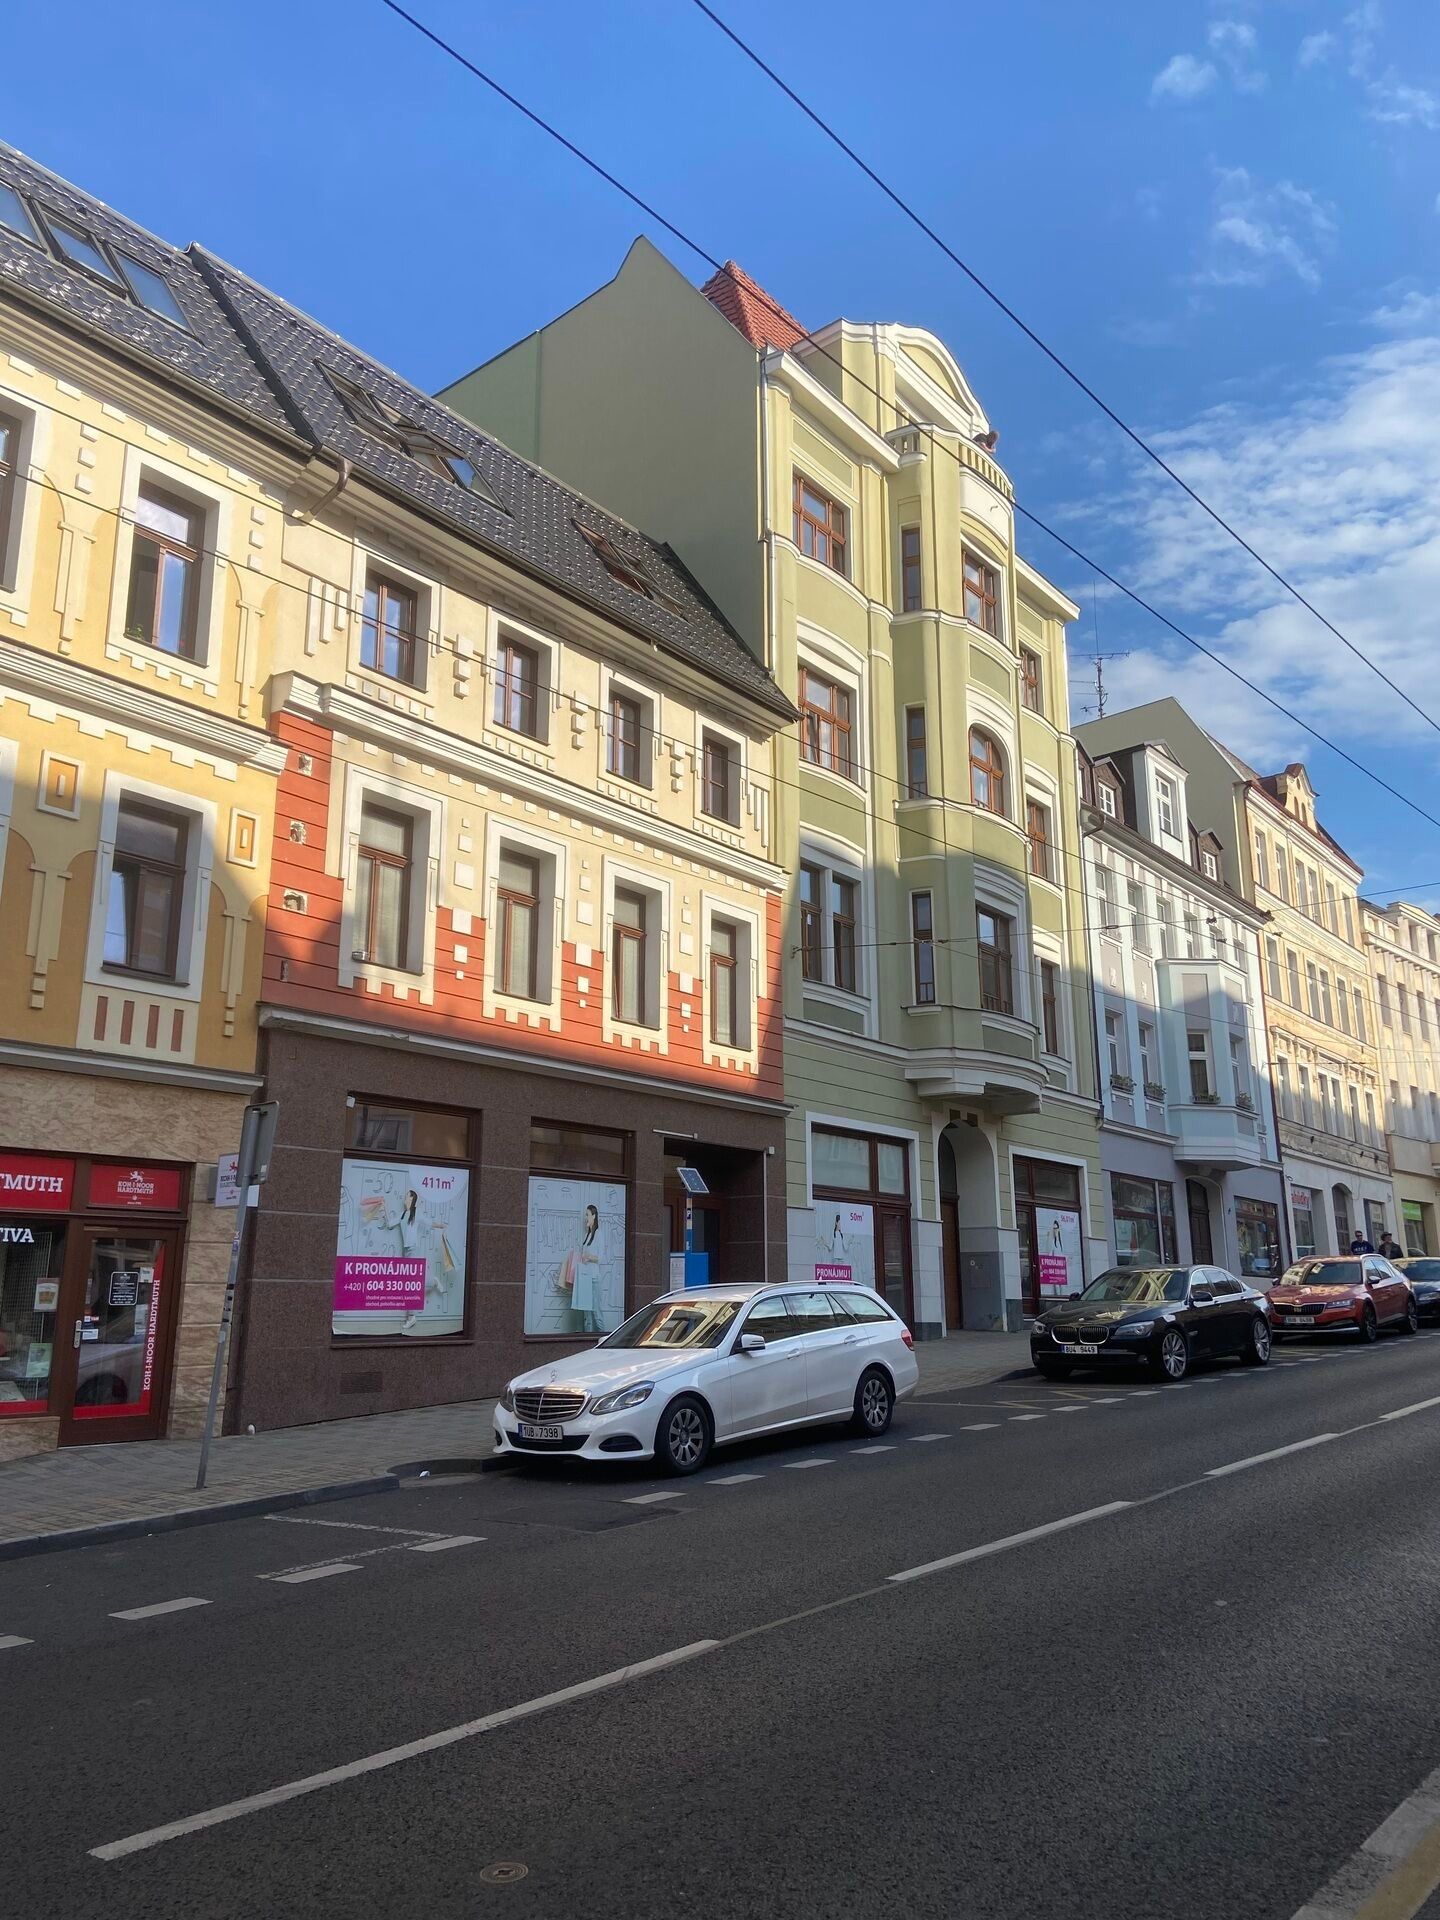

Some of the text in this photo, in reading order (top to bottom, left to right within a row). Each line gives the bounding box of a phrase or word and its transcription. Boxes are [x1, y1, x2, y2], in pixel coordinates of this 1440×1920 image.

[344, 1262, 353, 1275] K
[355, 1260, 418, 1276] PRONÁJMU
[343, 1282, 361, 1291] +420
[366, 1280, 384, 1291] 604
[386, 1281, 403, 1291] 330
[404, 1281, 422, 1291] 000
[148, 1279, 160, 1335] HARDTMUTH
[538, 1427, 559, 1439] 7398
